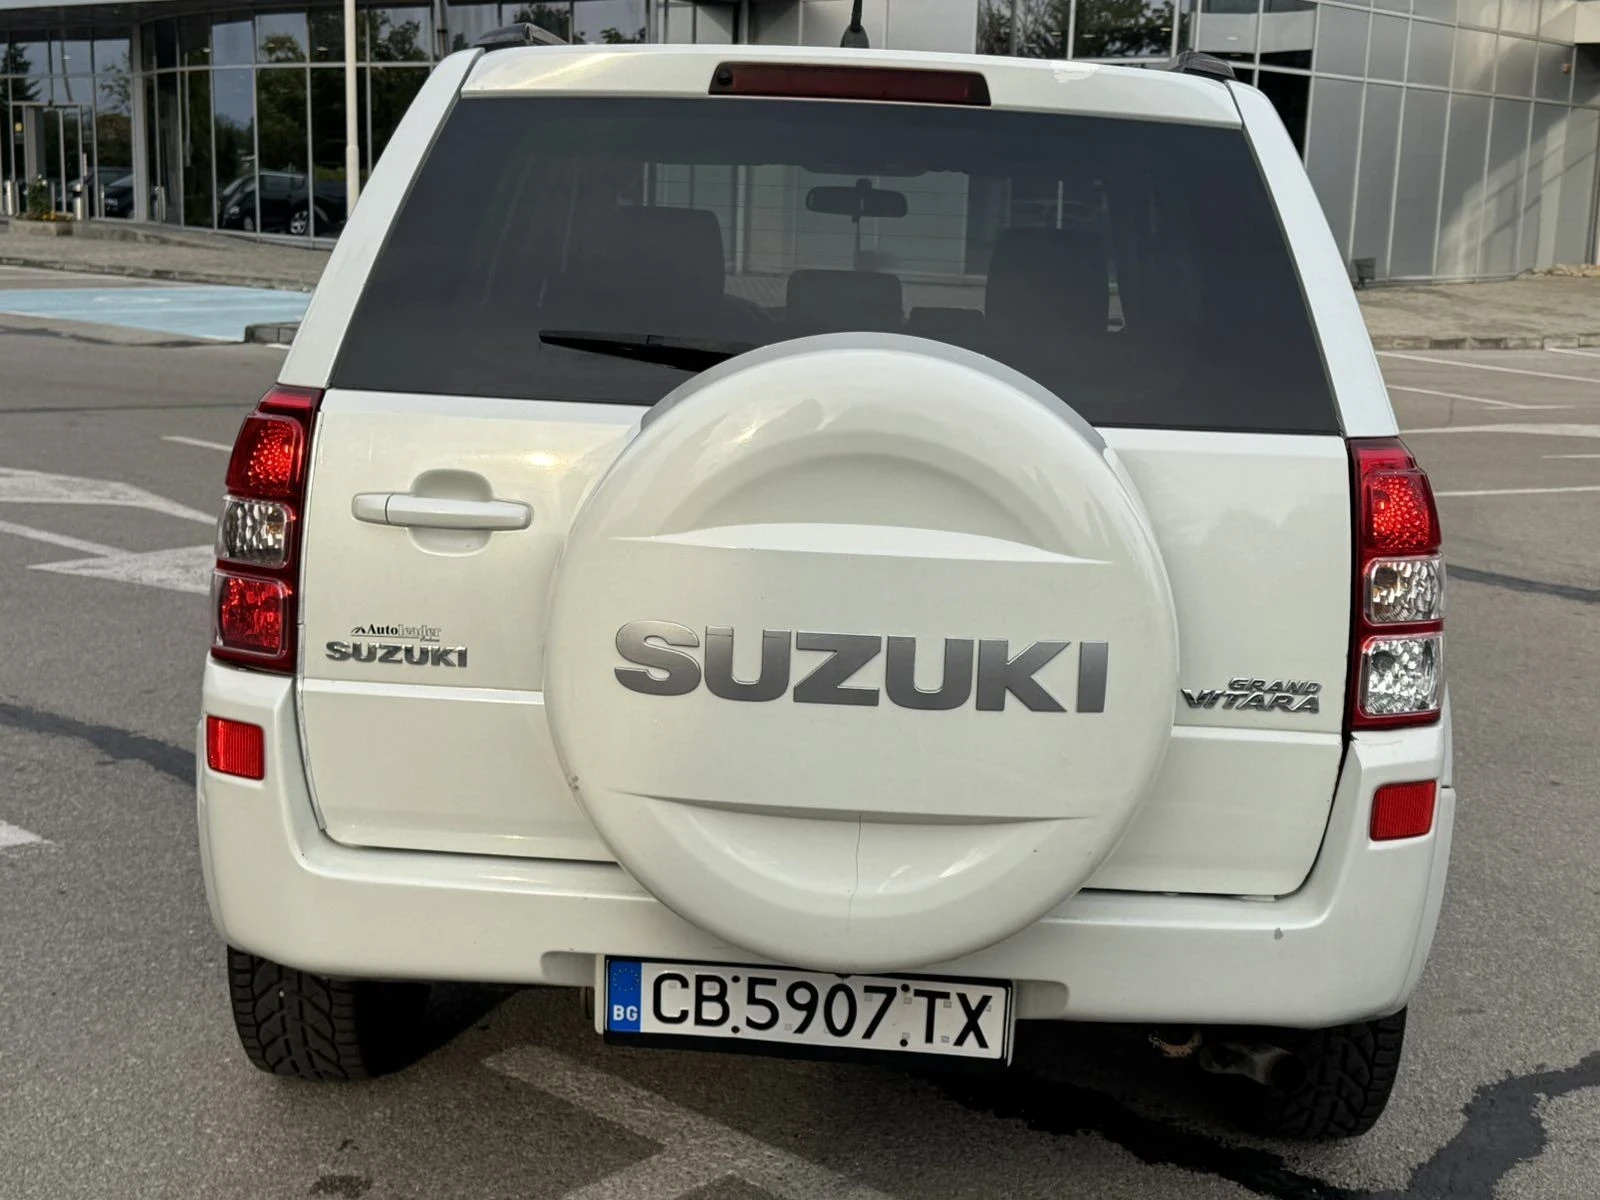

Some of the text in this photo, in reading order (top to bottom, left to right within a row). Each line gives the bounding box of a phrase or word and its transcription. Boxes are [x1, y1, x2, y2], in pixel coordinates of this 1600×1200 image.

[325, 641, 468, 668] SUZUKI
[615, 620, 1109, 713] SUZUKI
[1228, 677, 1323, 695] GRAND
[1181, 688, 1320, 714] VITARA
[613, 1005, 638, 1021] BG
[652, 972, 993, 1050] CB 5907 TX
